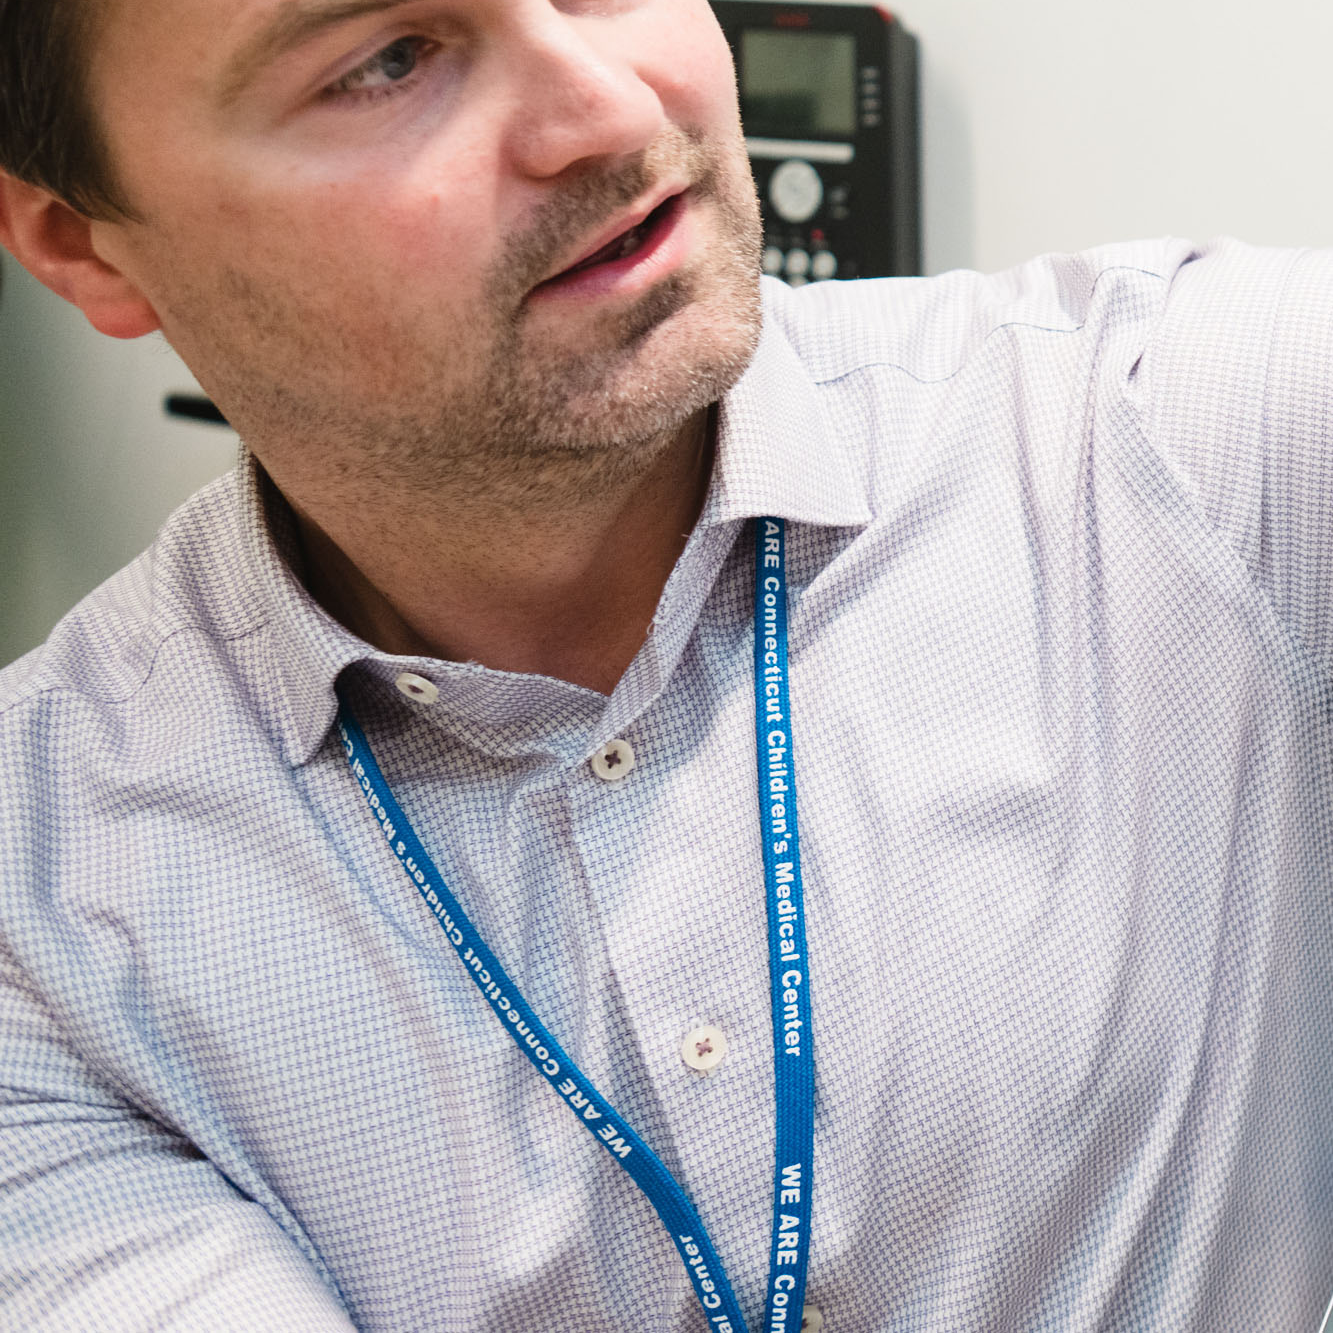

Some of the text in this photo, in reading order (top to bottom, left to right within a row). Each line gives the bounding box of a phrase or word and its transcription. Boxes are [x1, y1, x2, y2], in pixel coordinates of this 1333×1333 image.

[352, 758, 397, 841] Medical
[764, 520, 803, 1056] ARE Connecticut Children's Medical Center
[396, 841, 463, 946] Children's
[464, 947, 560, 1076] Connecticut
[558, 1078, 602, 1120] ARE
[597, 1123, 632, 1158] WE
[679, 1235, 722, 1309] Center
[770, 1163, 801, 1333] WE ARE Conn
